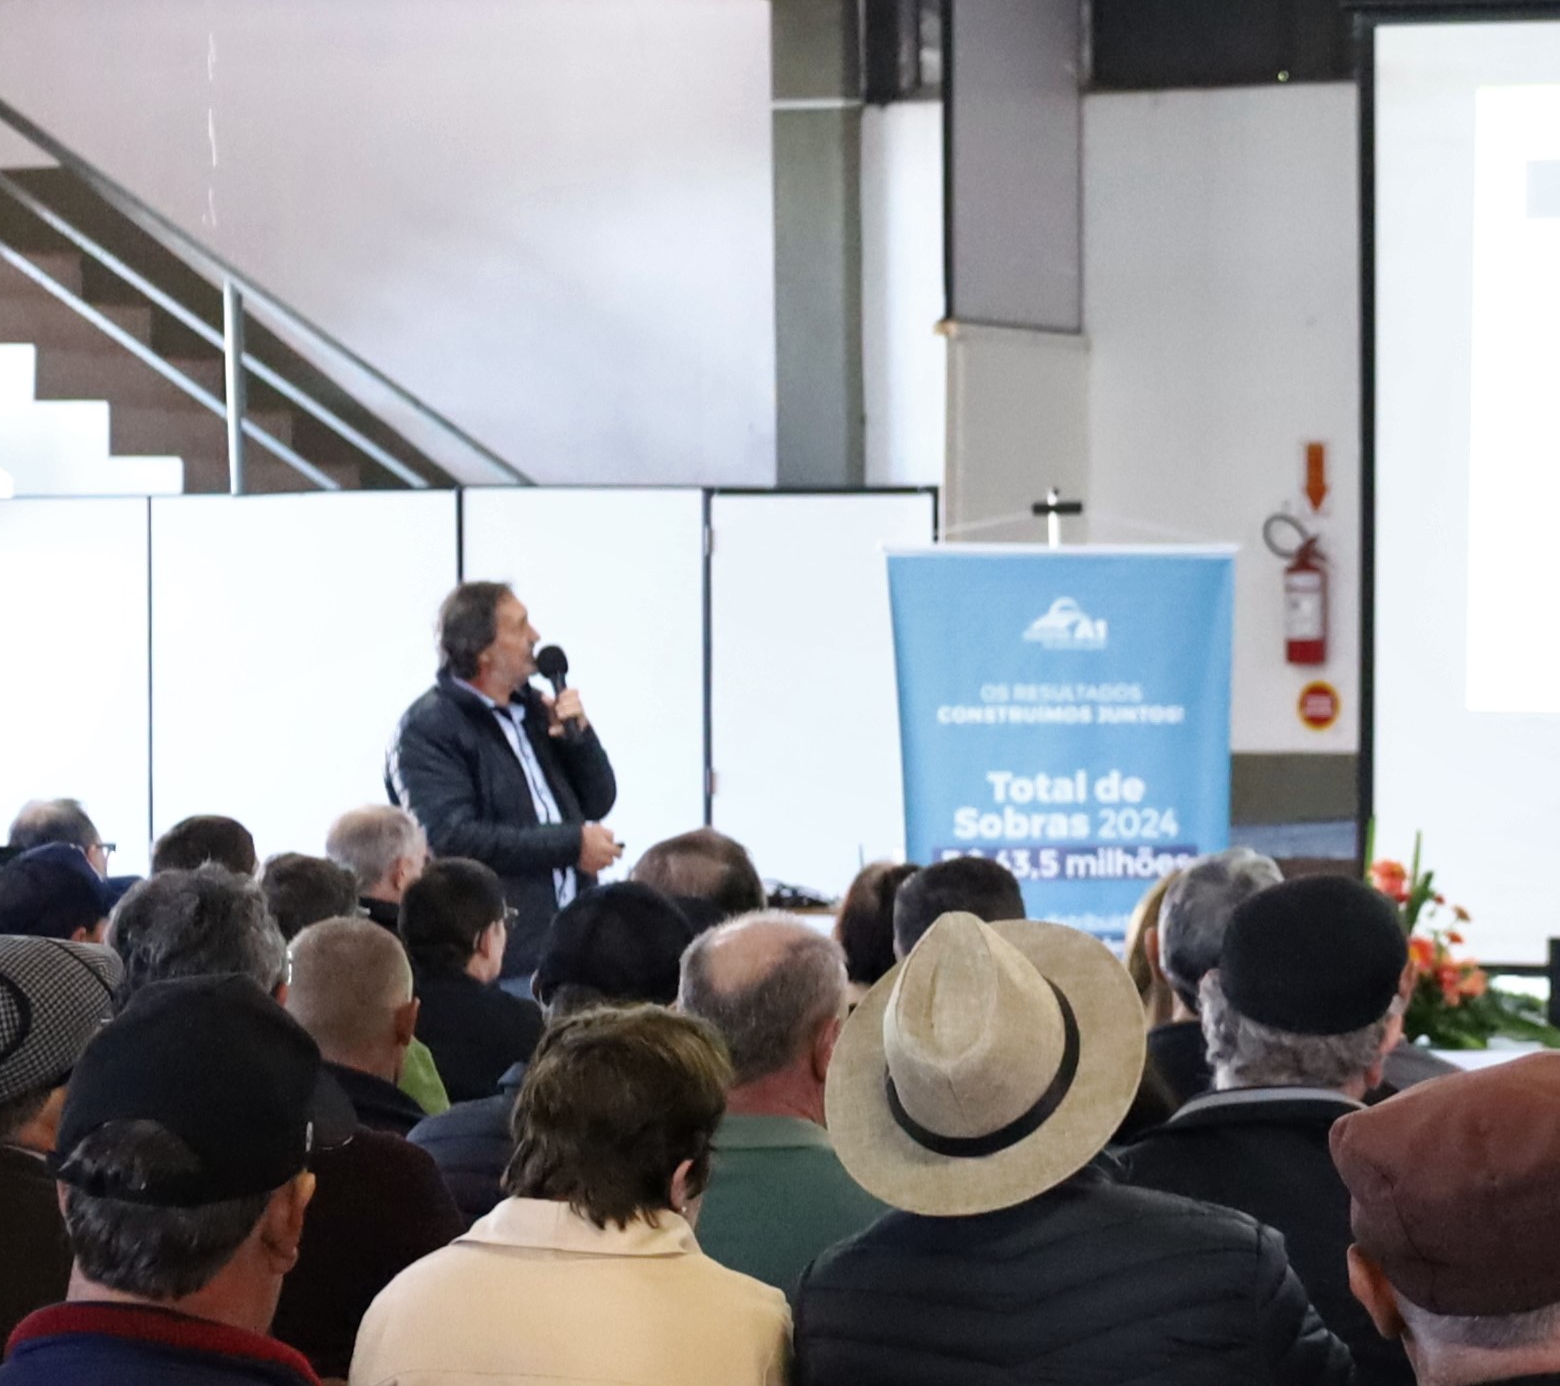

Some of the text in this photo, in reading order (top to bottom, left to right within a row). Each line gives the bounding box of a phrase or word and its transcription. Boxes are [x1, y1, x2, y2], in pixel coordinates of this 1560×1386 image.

[980, 682, 1144, 704] OS RESULTADOS
[987, 769, 1146, 804] Total de
[952, 805, 1179, 840] Sobras 2024
